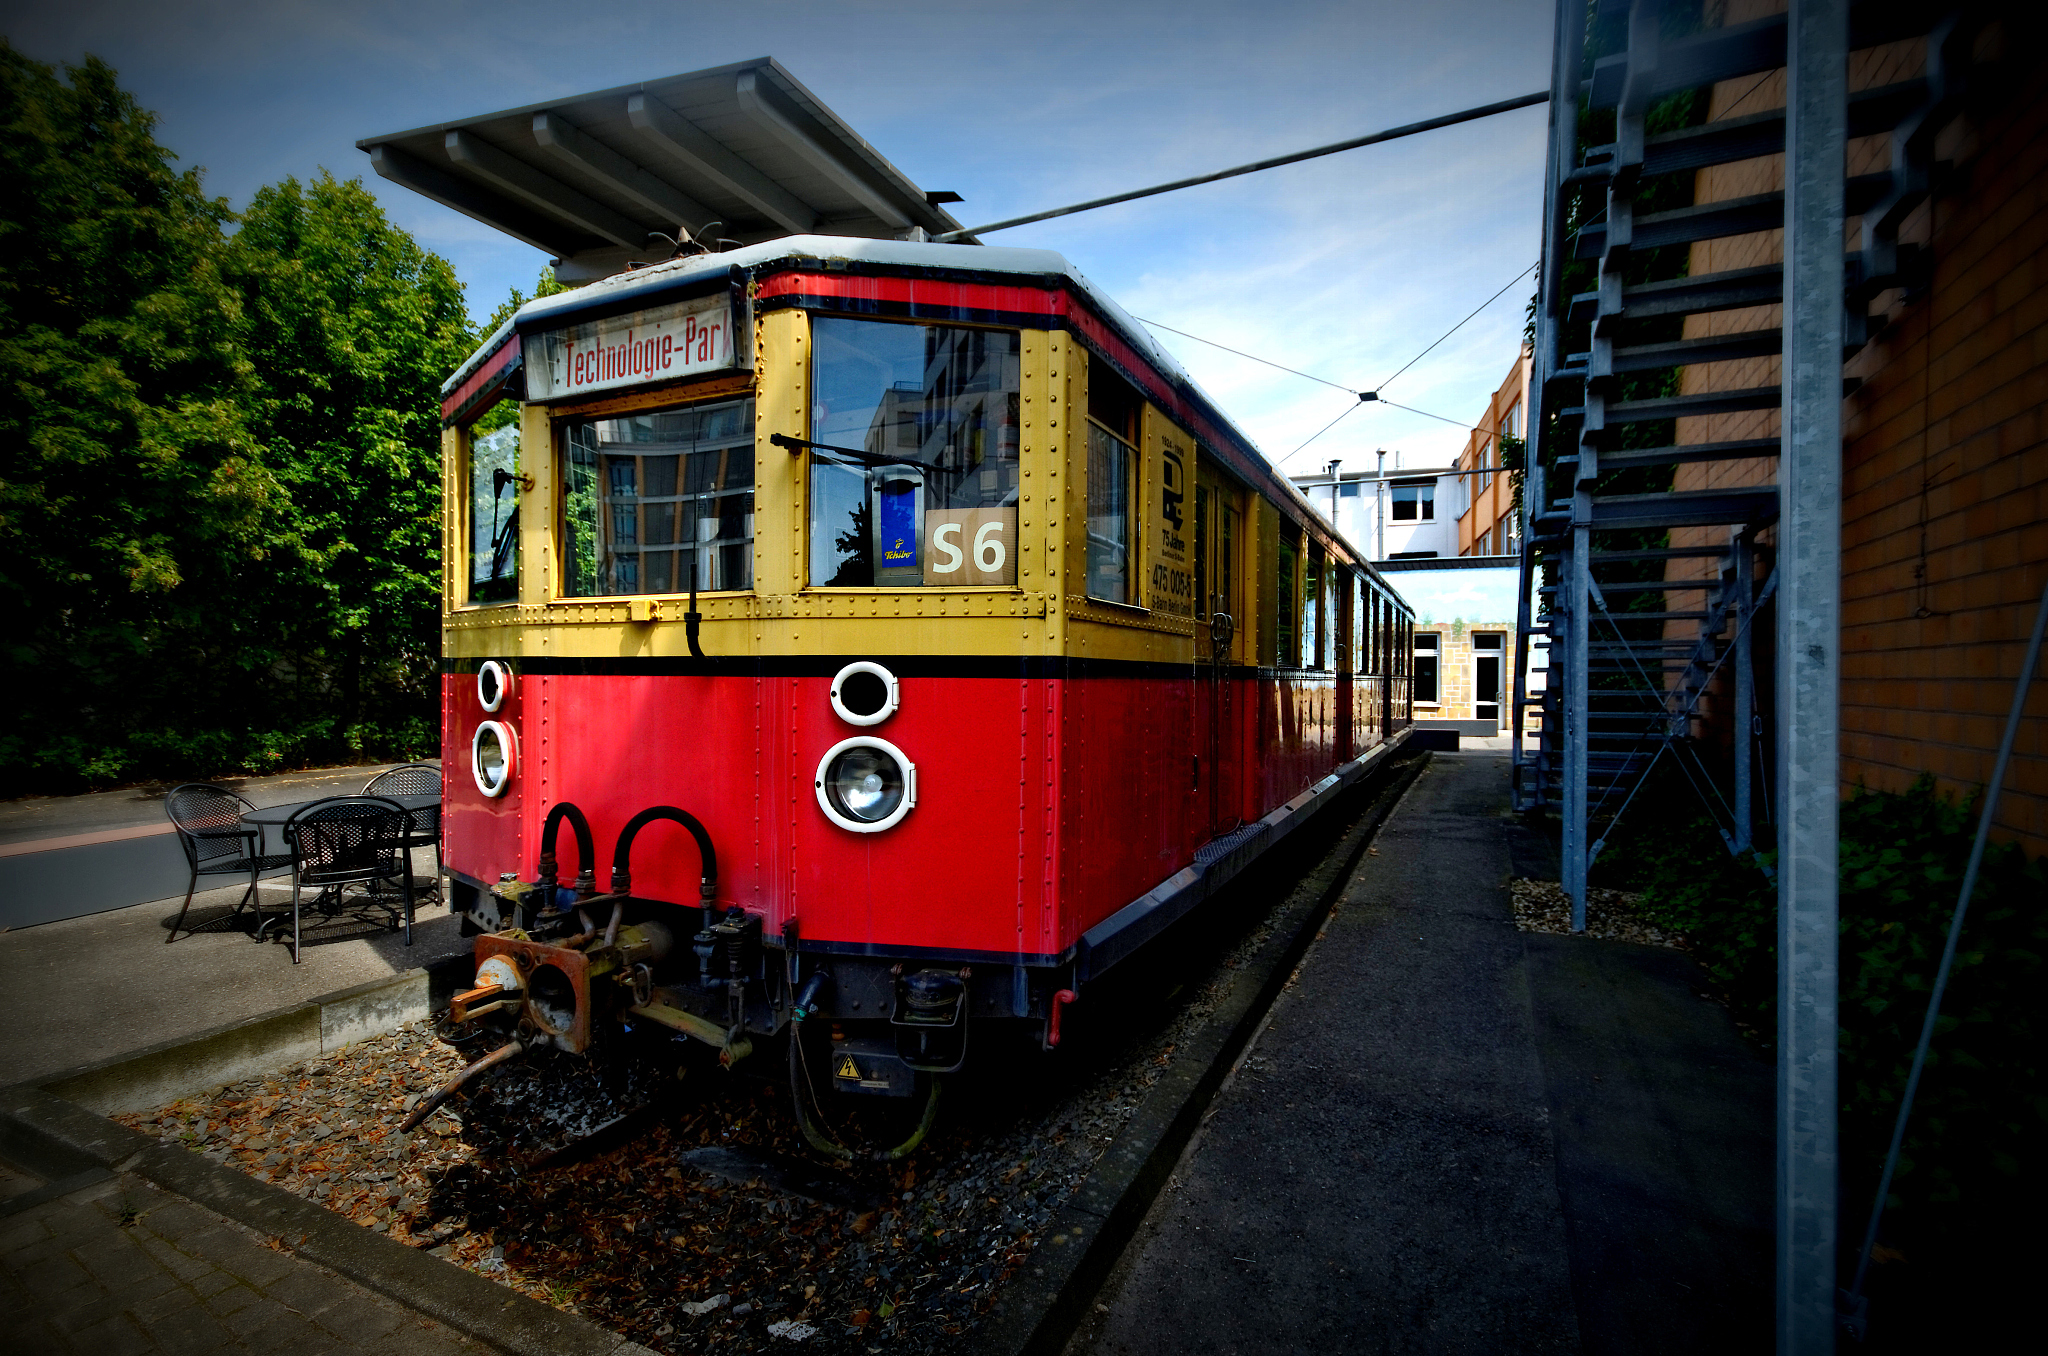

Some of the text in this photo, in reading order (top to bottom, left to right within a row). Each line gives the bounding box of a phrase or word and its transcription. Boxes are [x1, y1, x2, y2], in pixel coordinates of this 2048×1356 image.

[1162, 528, 1185, 553] 75 Jahre
[884, 550, 913, 560] Tchibo
[1153, 564, 1191, 598] 475 005-5
[1152, 595, 1167, 611] S-Bahn
